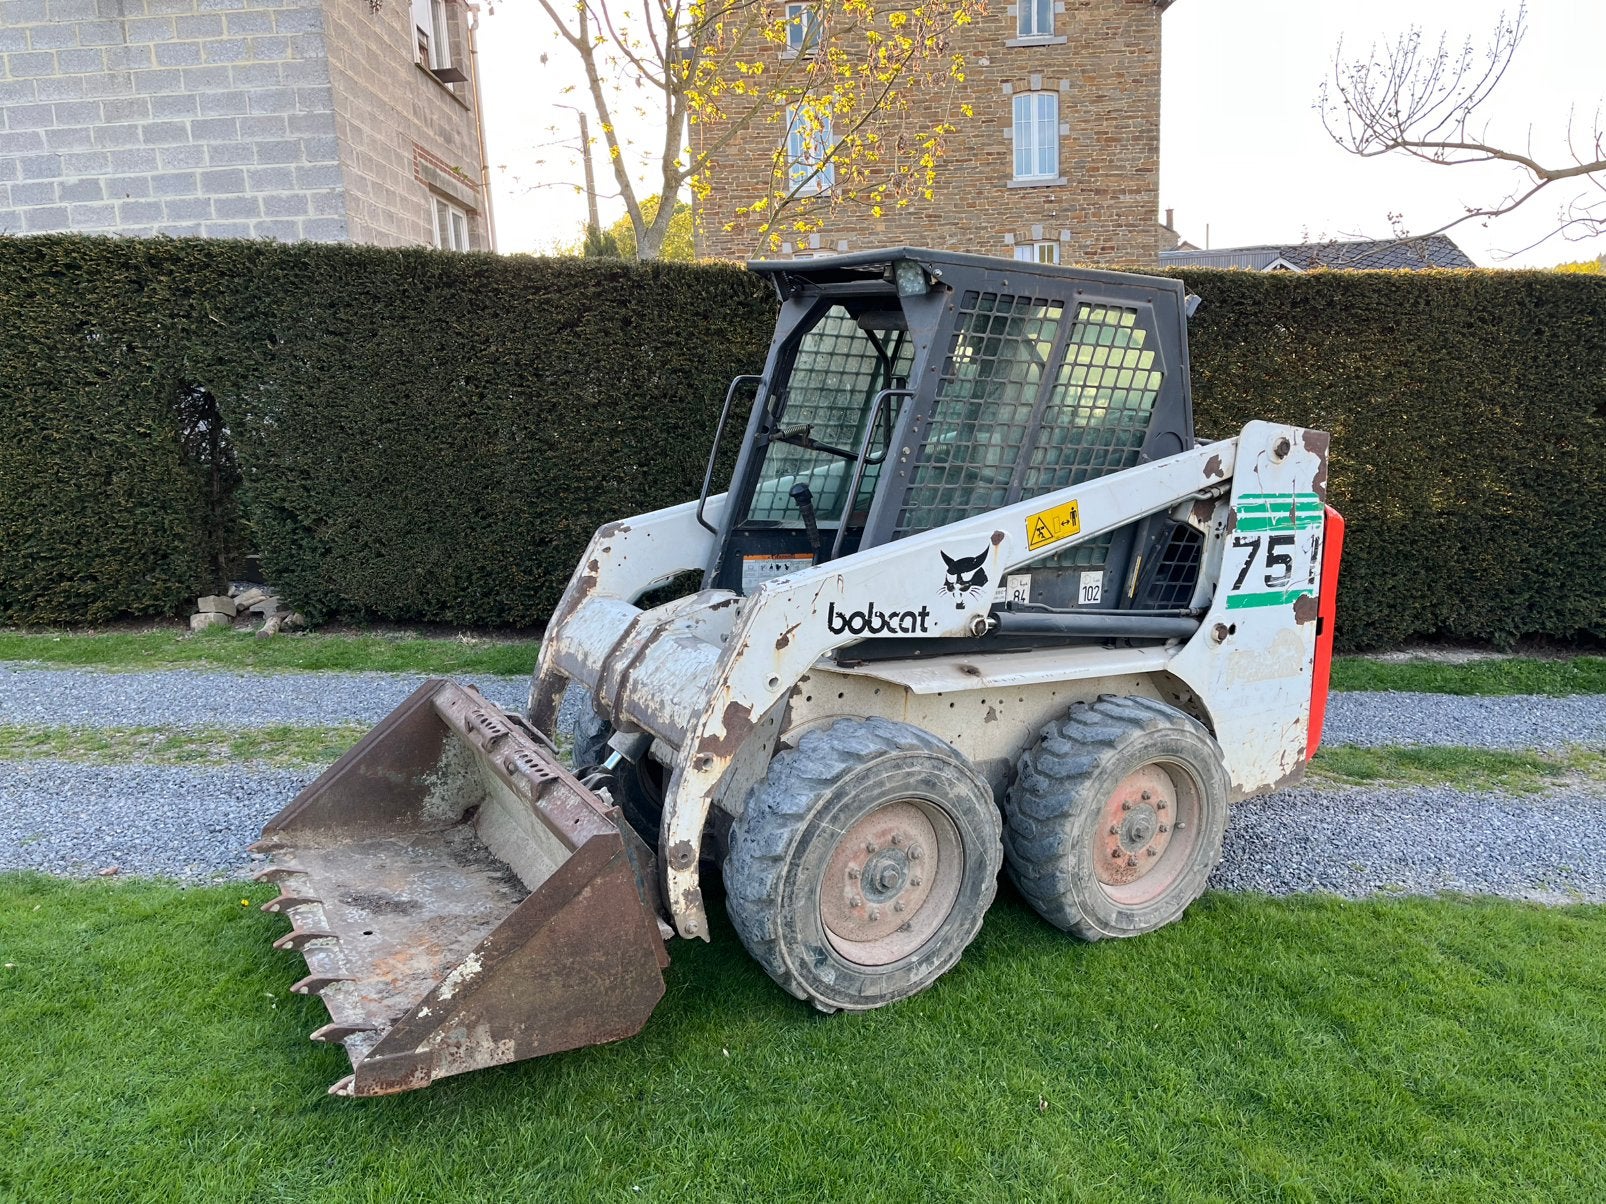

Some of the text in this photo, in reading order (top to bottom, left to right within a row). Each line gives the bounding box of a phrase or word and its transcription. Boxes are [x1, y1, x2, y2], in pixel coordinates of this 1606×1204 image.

[1013, 589, 1026, 602] 84
[1082, 586, 1100, 601] 102
[827, 602, 930, 635] bobcat
